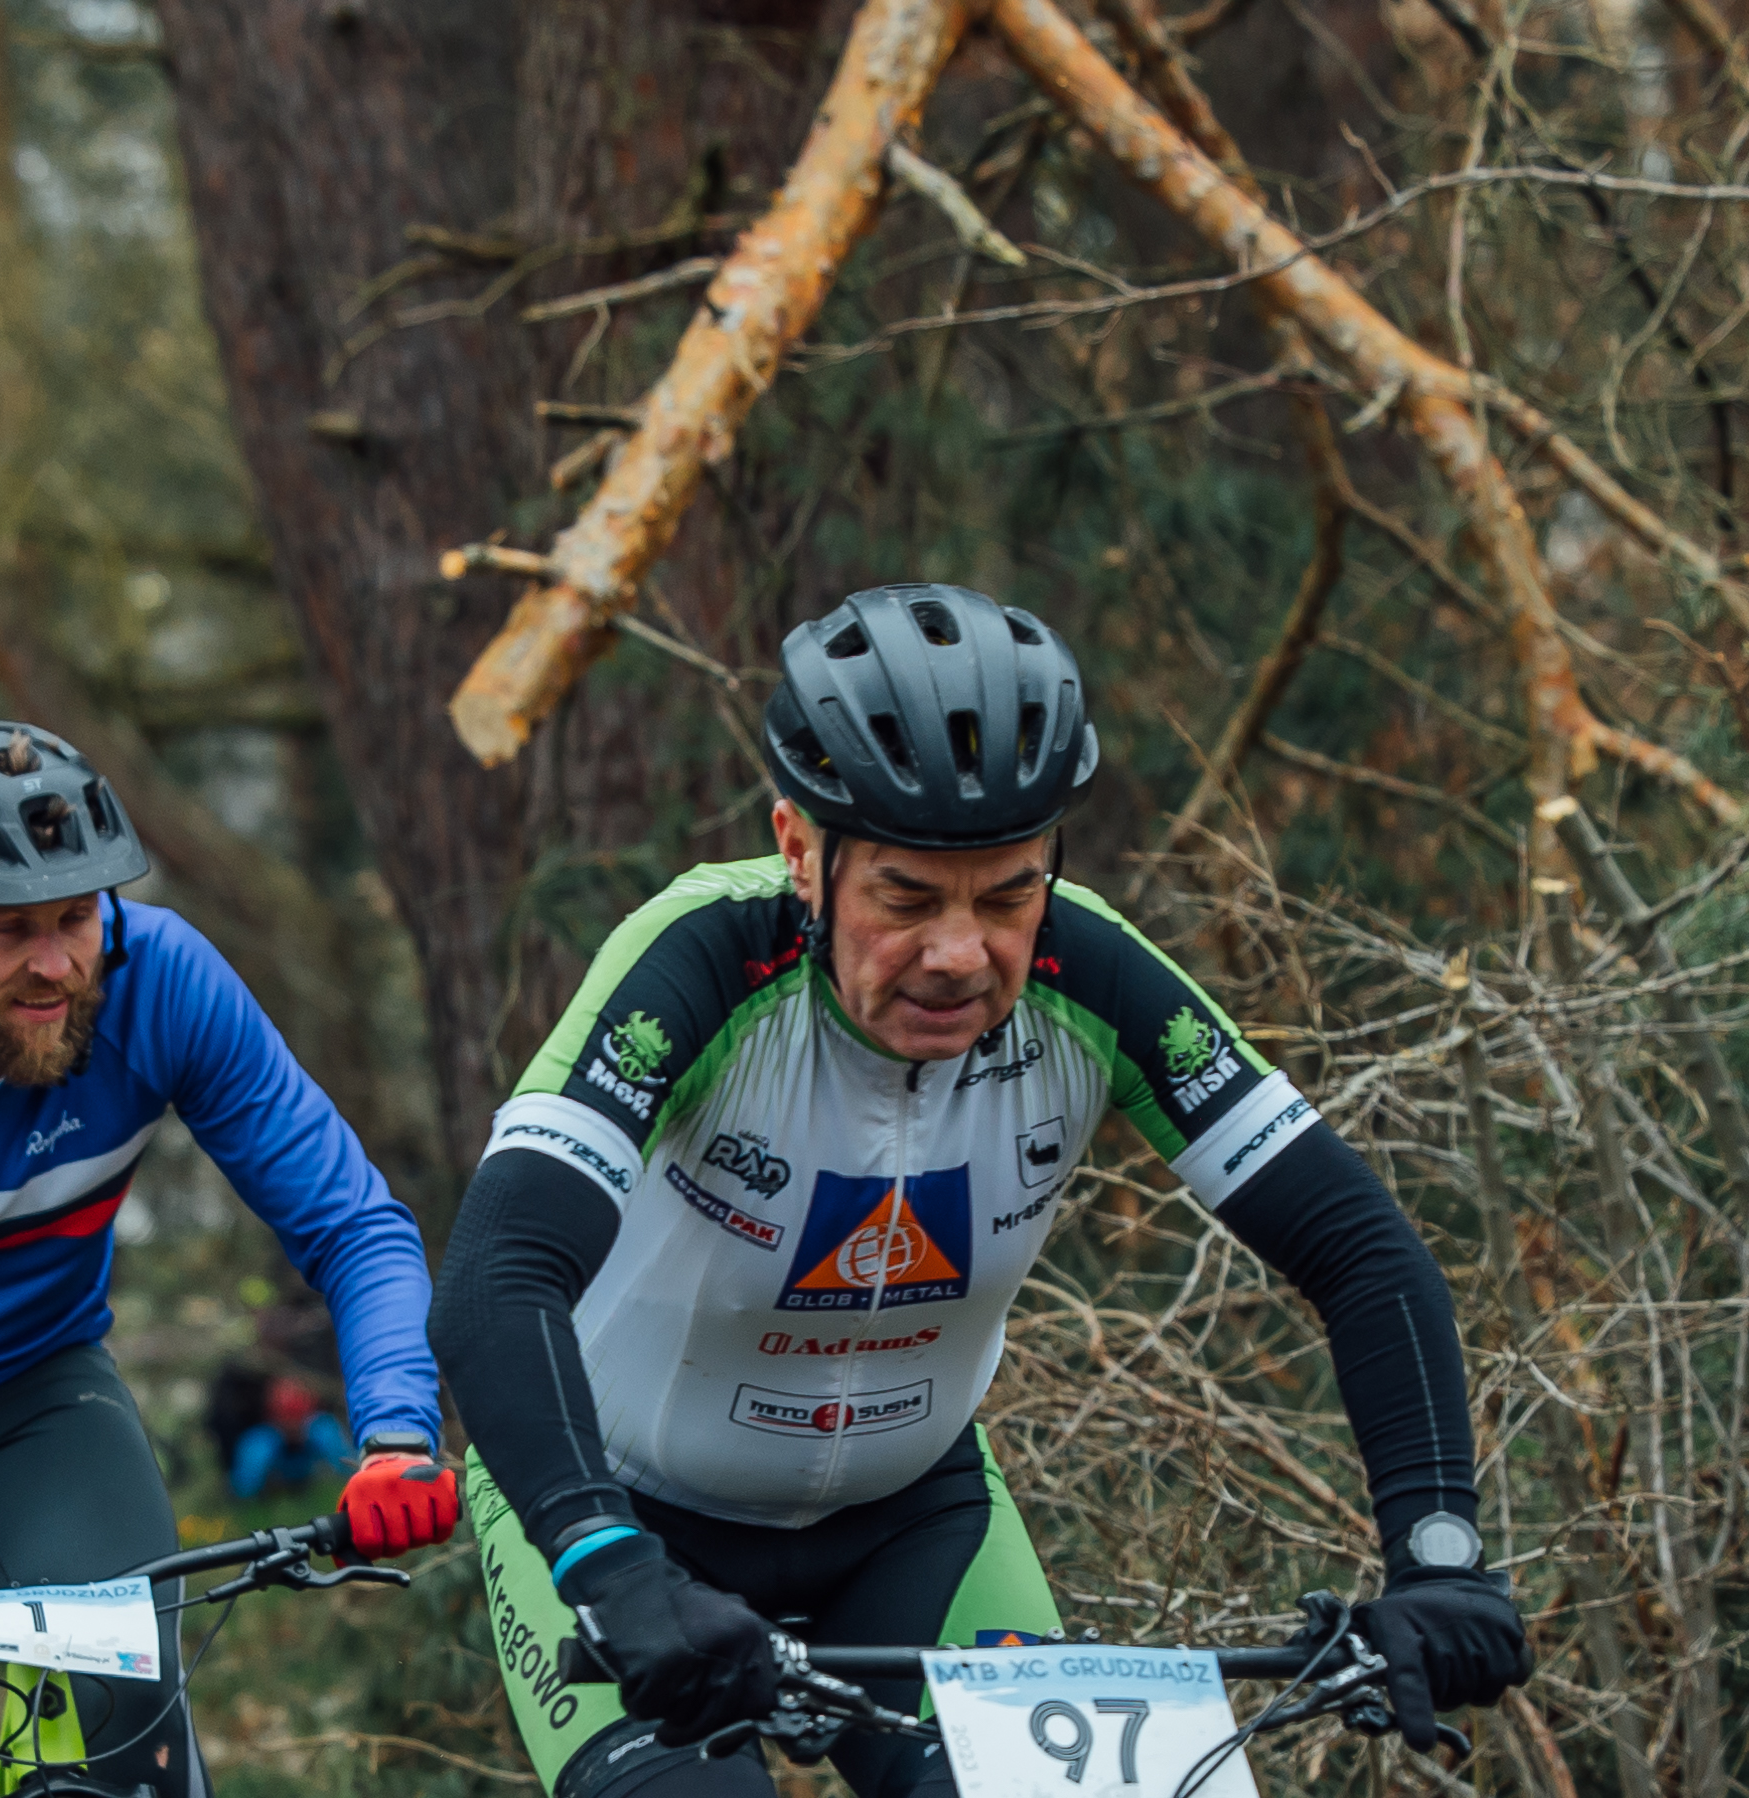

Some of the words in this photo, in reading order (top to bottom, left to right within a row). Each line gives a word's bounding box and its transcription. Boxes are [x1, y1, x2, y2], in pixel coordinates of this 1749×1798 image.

[728, 1214, 776, 1242] PAK
[785, 1294, 853, 1307] GLOB
[885, 1285, 958, 1302] METAL
[858, 1395, 922, 1419] SUSHI
[22, 1601, 48, 1633] 1
[933, 1661, 999, 1684] MTB
[1009, 1658, 1048, 1681] XC
[1029, 1698, 1151, 1784] 97
